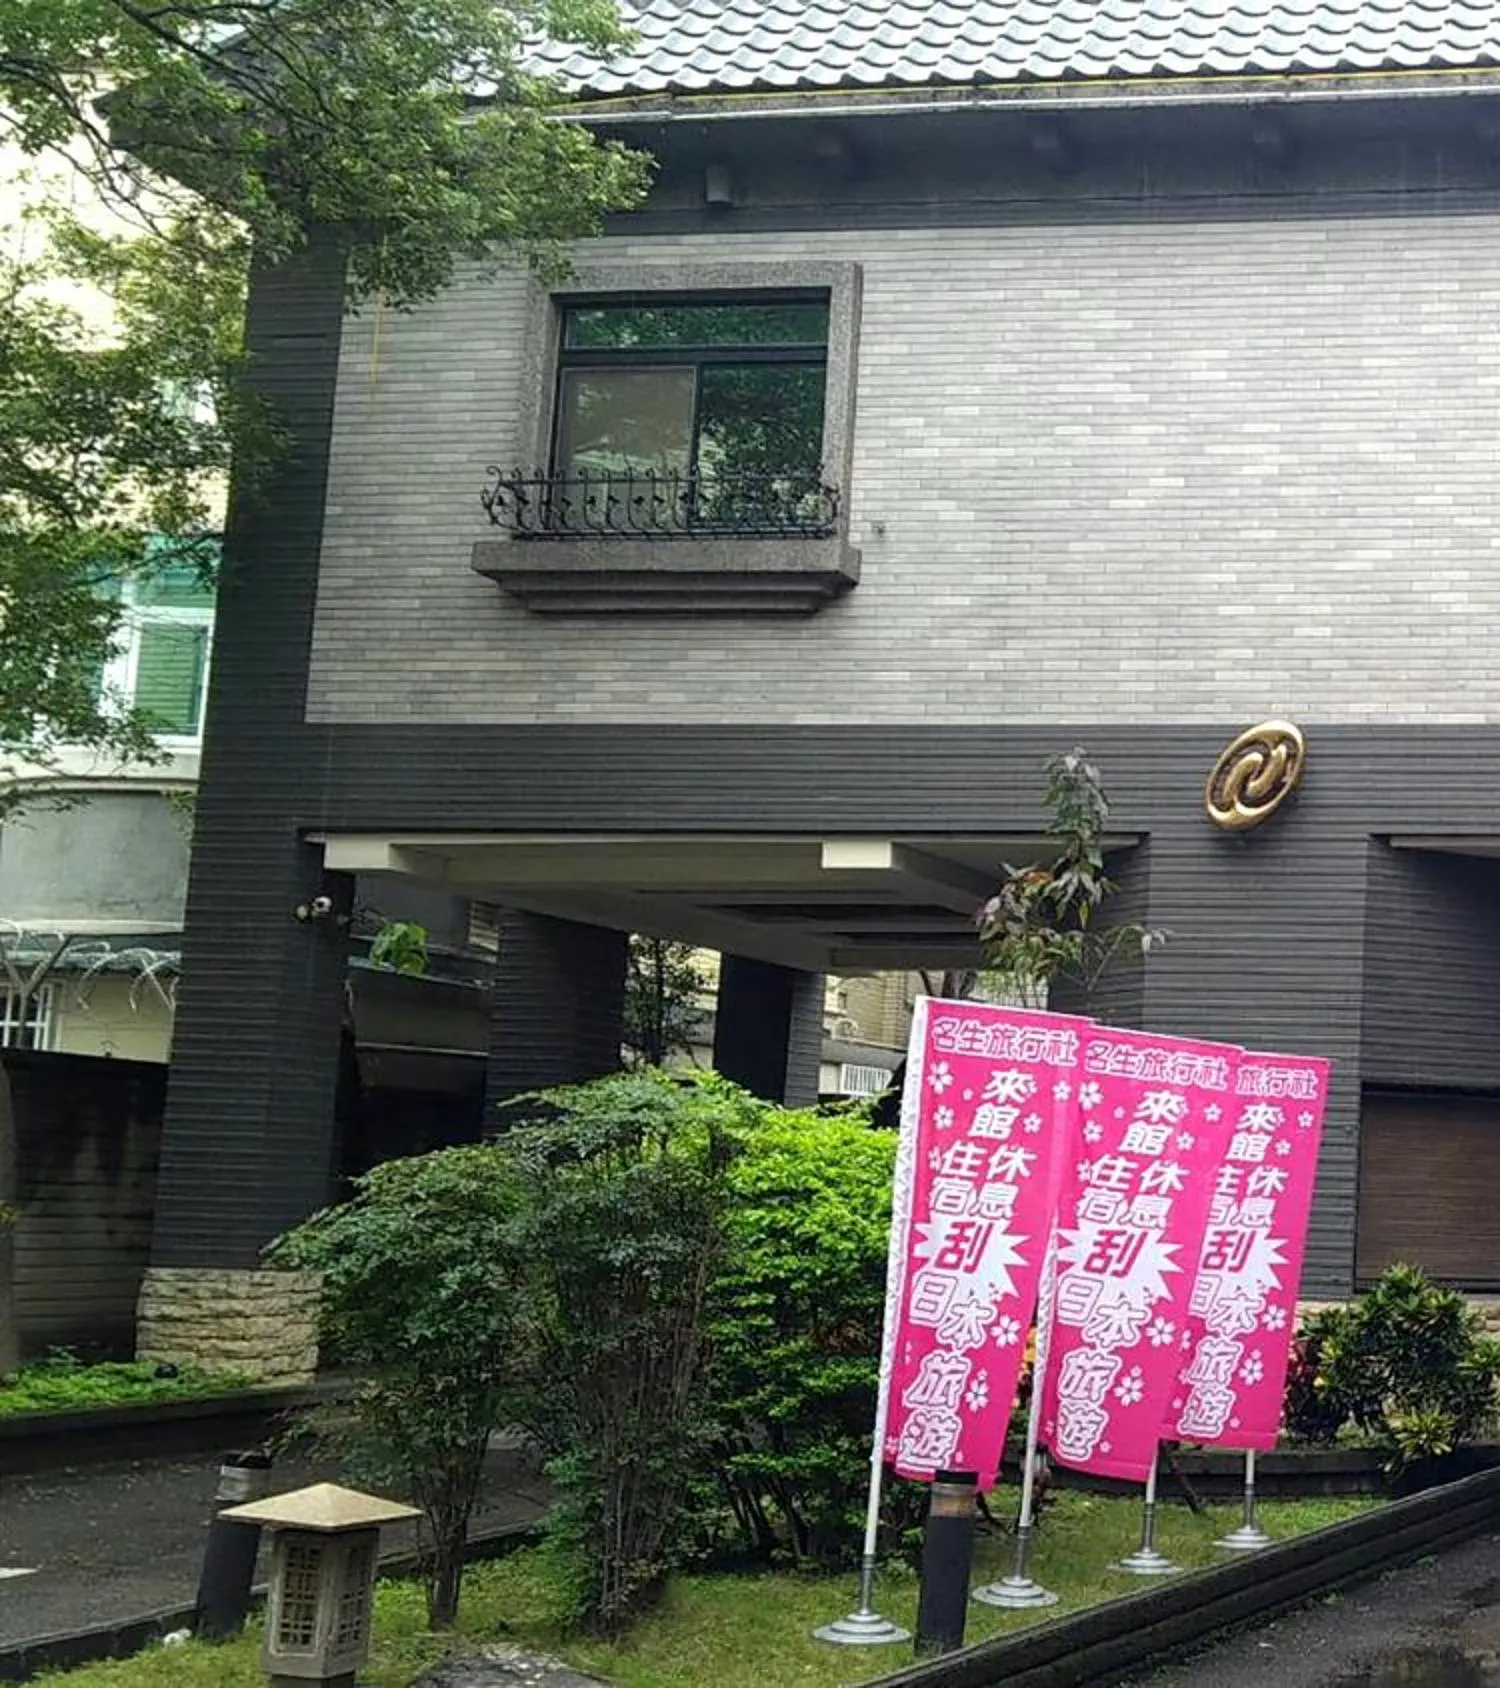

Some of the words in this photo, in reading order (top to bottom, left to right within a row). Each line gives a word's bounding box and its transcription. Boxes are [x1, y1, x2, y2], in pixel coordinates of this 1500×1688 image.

[932, 1016, 1078, 1067] 名生旅行社
[1084, 1040, 1229, 1091] 名生旅行社
[929, 1139, 988, 1217] 住宿
[969, 1143, 1037, 1219] 休息
[1075, 1154, 1139, 1225] 住宿
[1119, 1160, 1190, 1229] 休息
[1231, 1166, 1289, 1230] 休息
